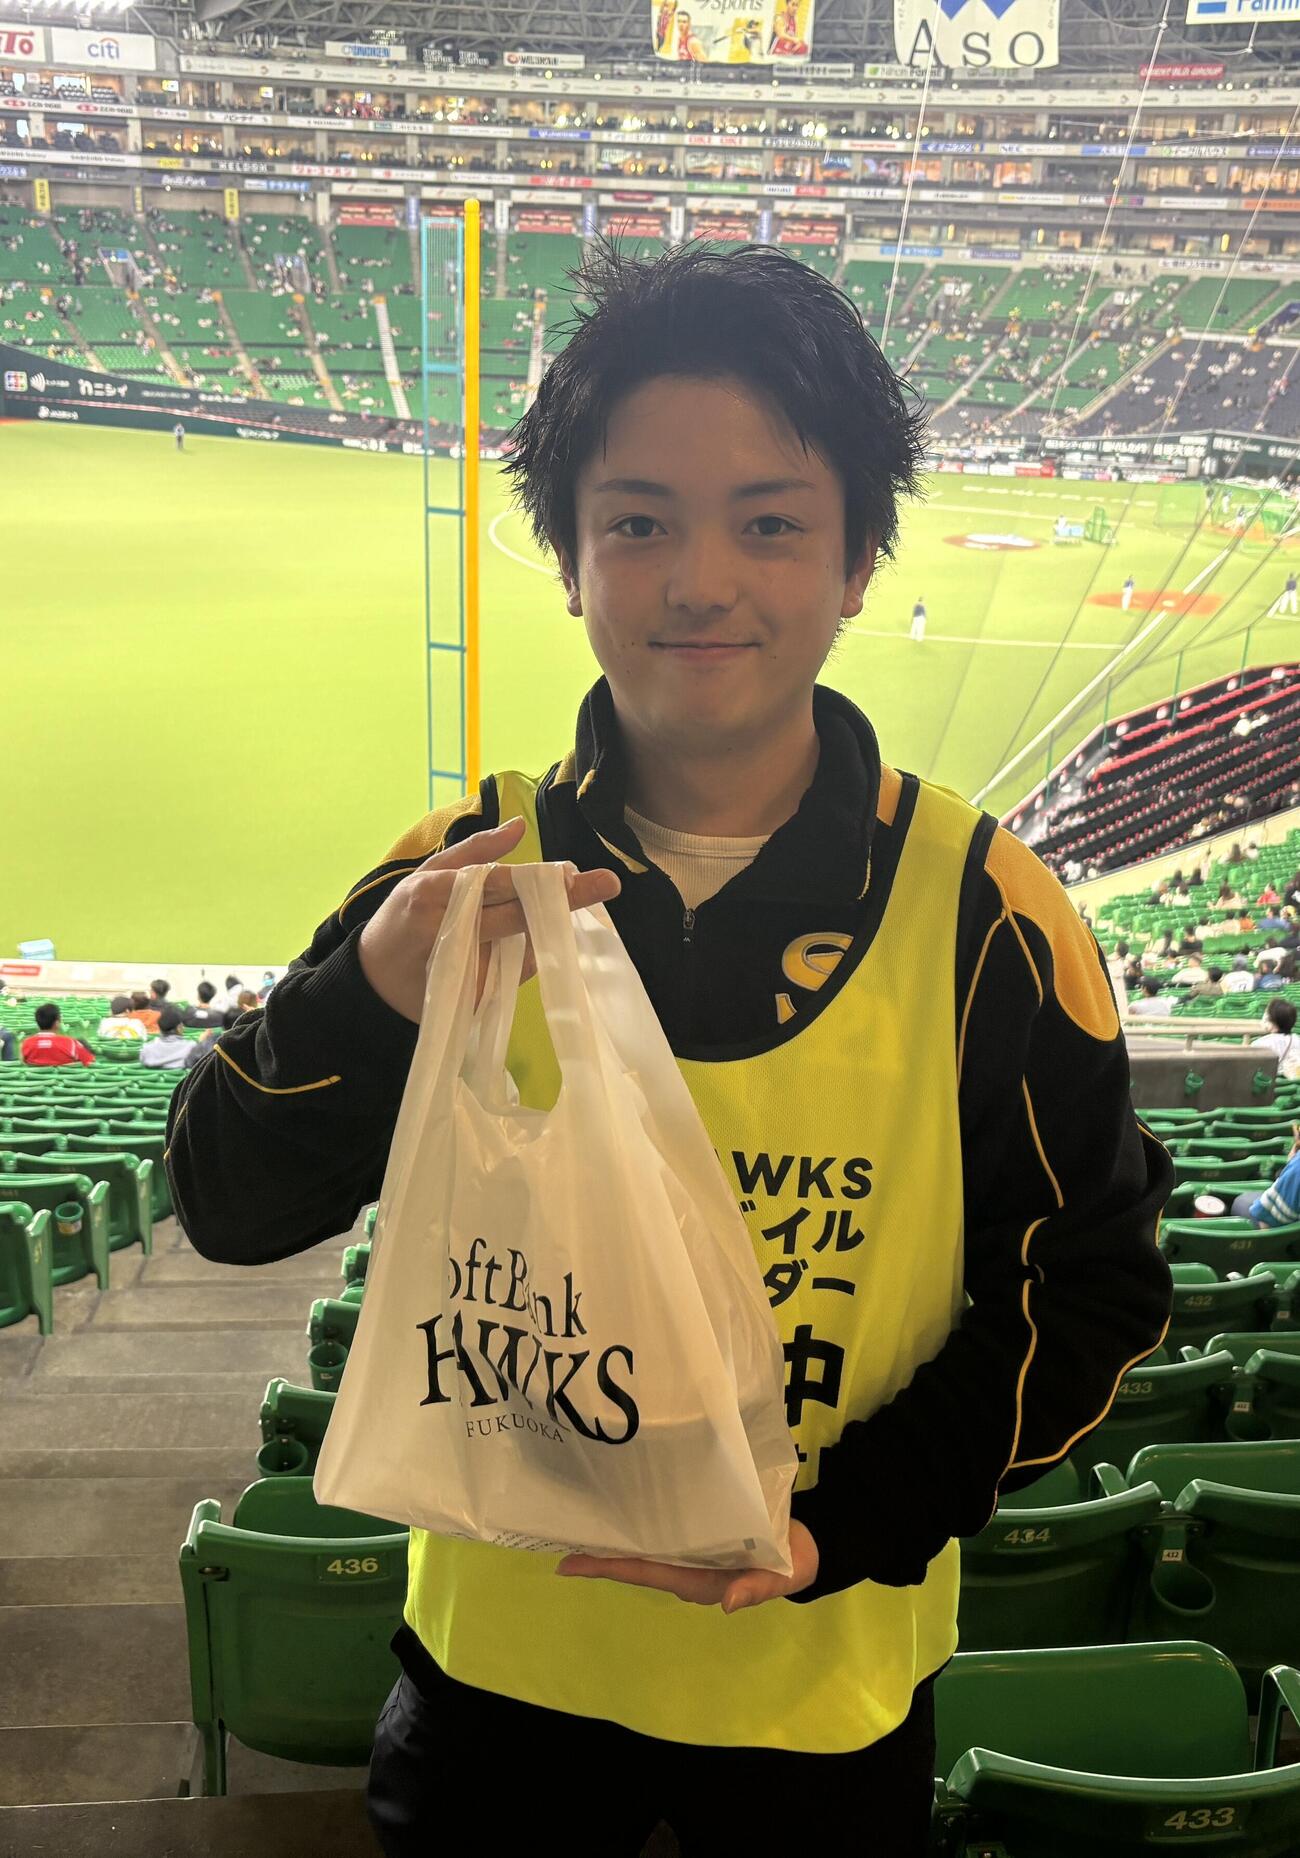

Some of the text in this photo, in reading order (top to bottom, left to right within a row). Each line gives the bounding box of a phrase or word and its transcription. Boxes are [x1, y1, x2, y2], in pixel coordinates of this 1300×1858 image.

[88, 42, 120, 59] citi
[905, 18, 1045, 69] ASO
[716, 1150, 873, 1200] WKS
[740, 1200, 865, 1255] イル
[1184, 1294, 1213, 1308] 432
[1118, 1380, 1153, 1396] 433
[465, 1414, 564, 1444] FUKUOKA
[1004, 1526, 1051, 1546] 434
[327, 1557, 378, 1575] 436
[1163, 1806, 1236, 1831] 433
